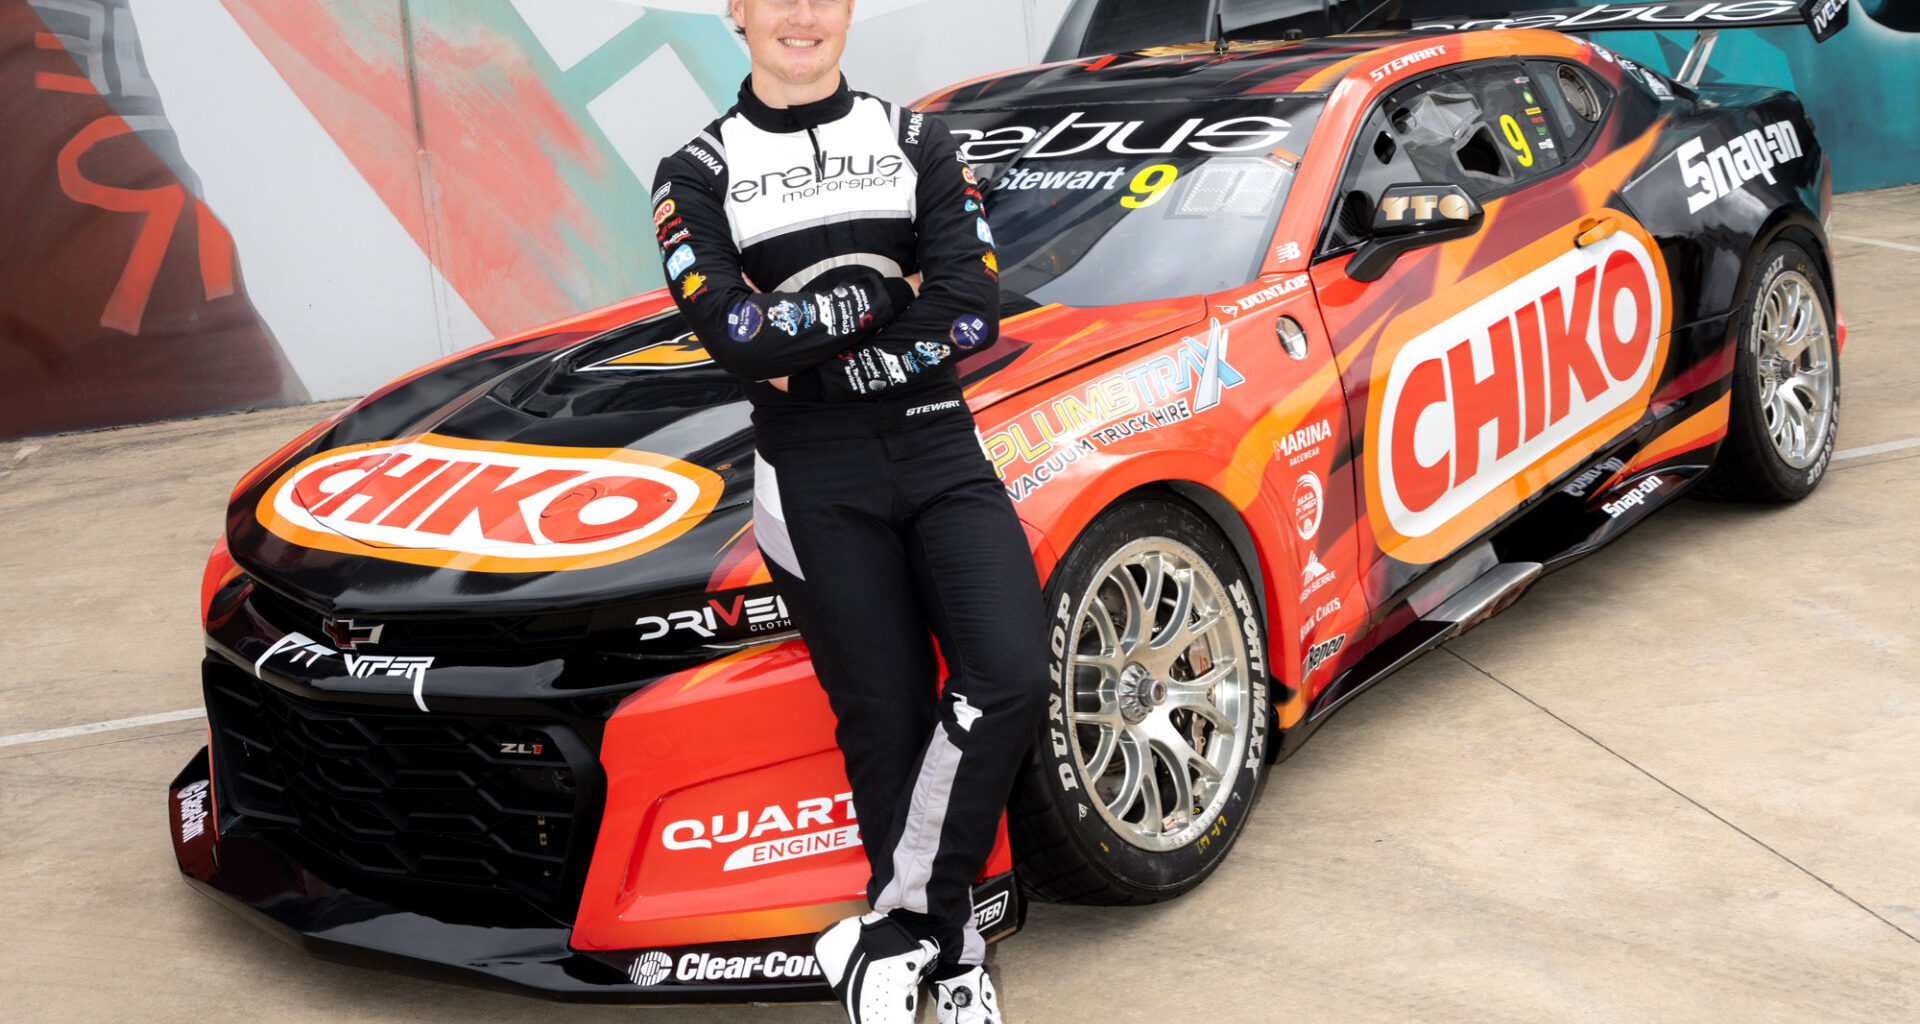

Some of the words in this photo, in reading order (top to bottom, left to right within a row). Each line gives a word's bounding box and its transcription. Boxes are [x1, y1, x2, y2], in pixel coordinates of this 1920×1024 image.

[1369, 45, 1446, 82] STEWART
[1500, 114, 1533, 167] 9
[731, 150, 902, 203] erebus
[783, 176, 901, 203] motorsport
[993, 166, 1125, 191] Stewart
[1120, 164, 1178, 208] 9
[1678, 119, 1803, 214] Snap-on
[1237, 274, 1309, 310] DUNLOP
[985, 317, 1245, 480] PLUMBTRAX
[1391, 249, 1652, 513] CHIKO
[906, 400, 960, 416] STEWART
[1006, 440, 1094, 503] VACUUM
[1093, 415, 1149, 449] TRUCK
[1154, 399, 1190, 428] HIRE
[1273, 419, 1332, 461] MARINA
[1289, 446, 1320, 467] RACEWEAR
[290, 452, 678, 545] CHIKO
[1601, 475, 1664, 518] Snap-on
[1228, 579, 1264, 682] SPORT
[344, 655, 434, 712] VIPER
[1049, 592, 1079, 792] DUNLOP
[500, 743, 543, 755] ZL1
[1245, 680, 1267, 780] MAXX
[752, 831, 848, 862] ENGINE
